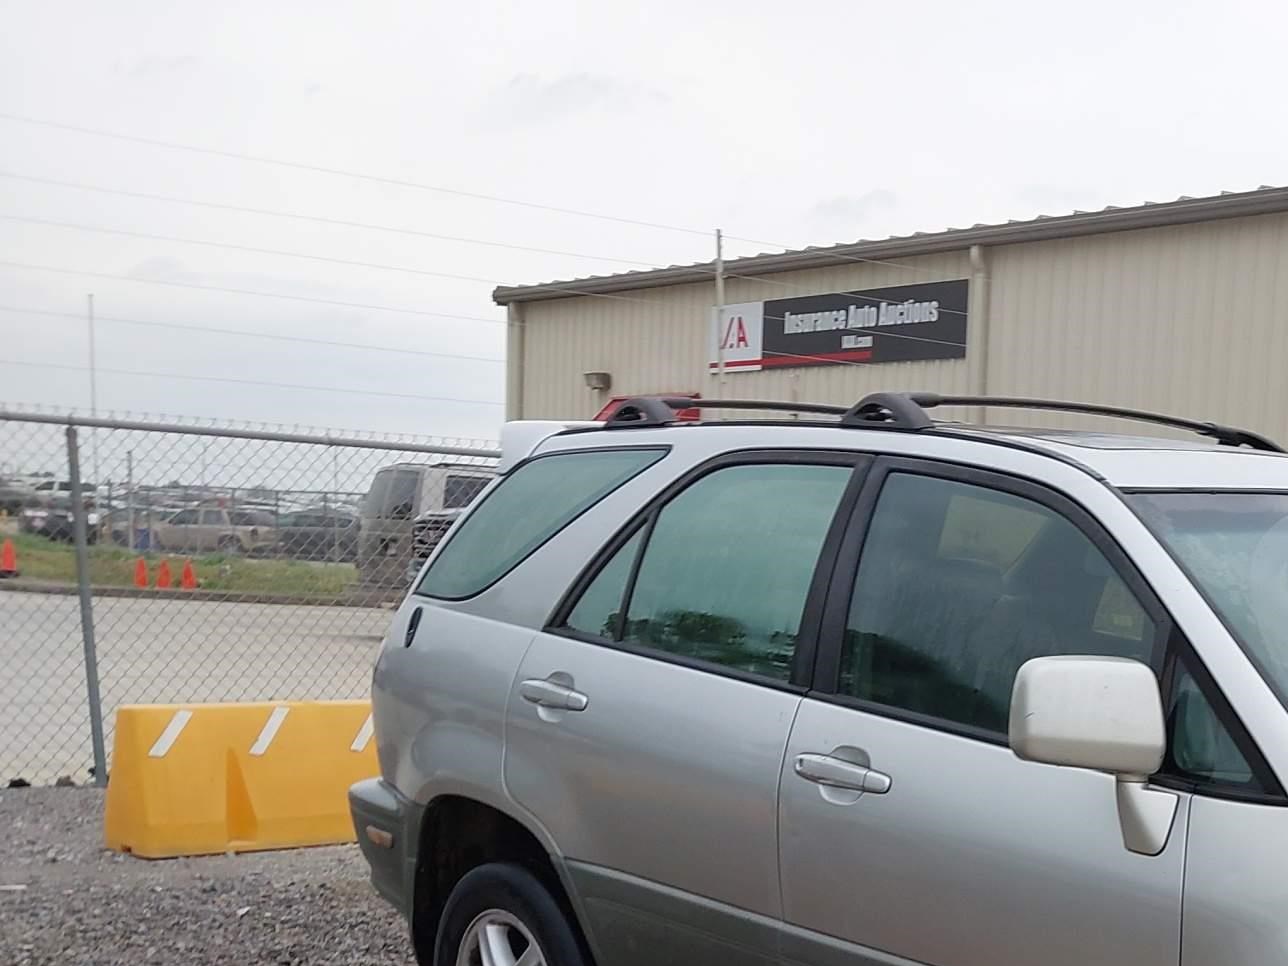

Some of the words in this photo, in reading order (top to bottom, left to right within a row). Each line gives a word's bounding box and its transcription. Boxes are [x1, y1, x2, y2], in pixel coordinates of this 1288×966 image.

[783, 309, 847, 335] Insurance
[846, 304, 878, 329] Auto
[877, 299, 939, 327] Auctions
